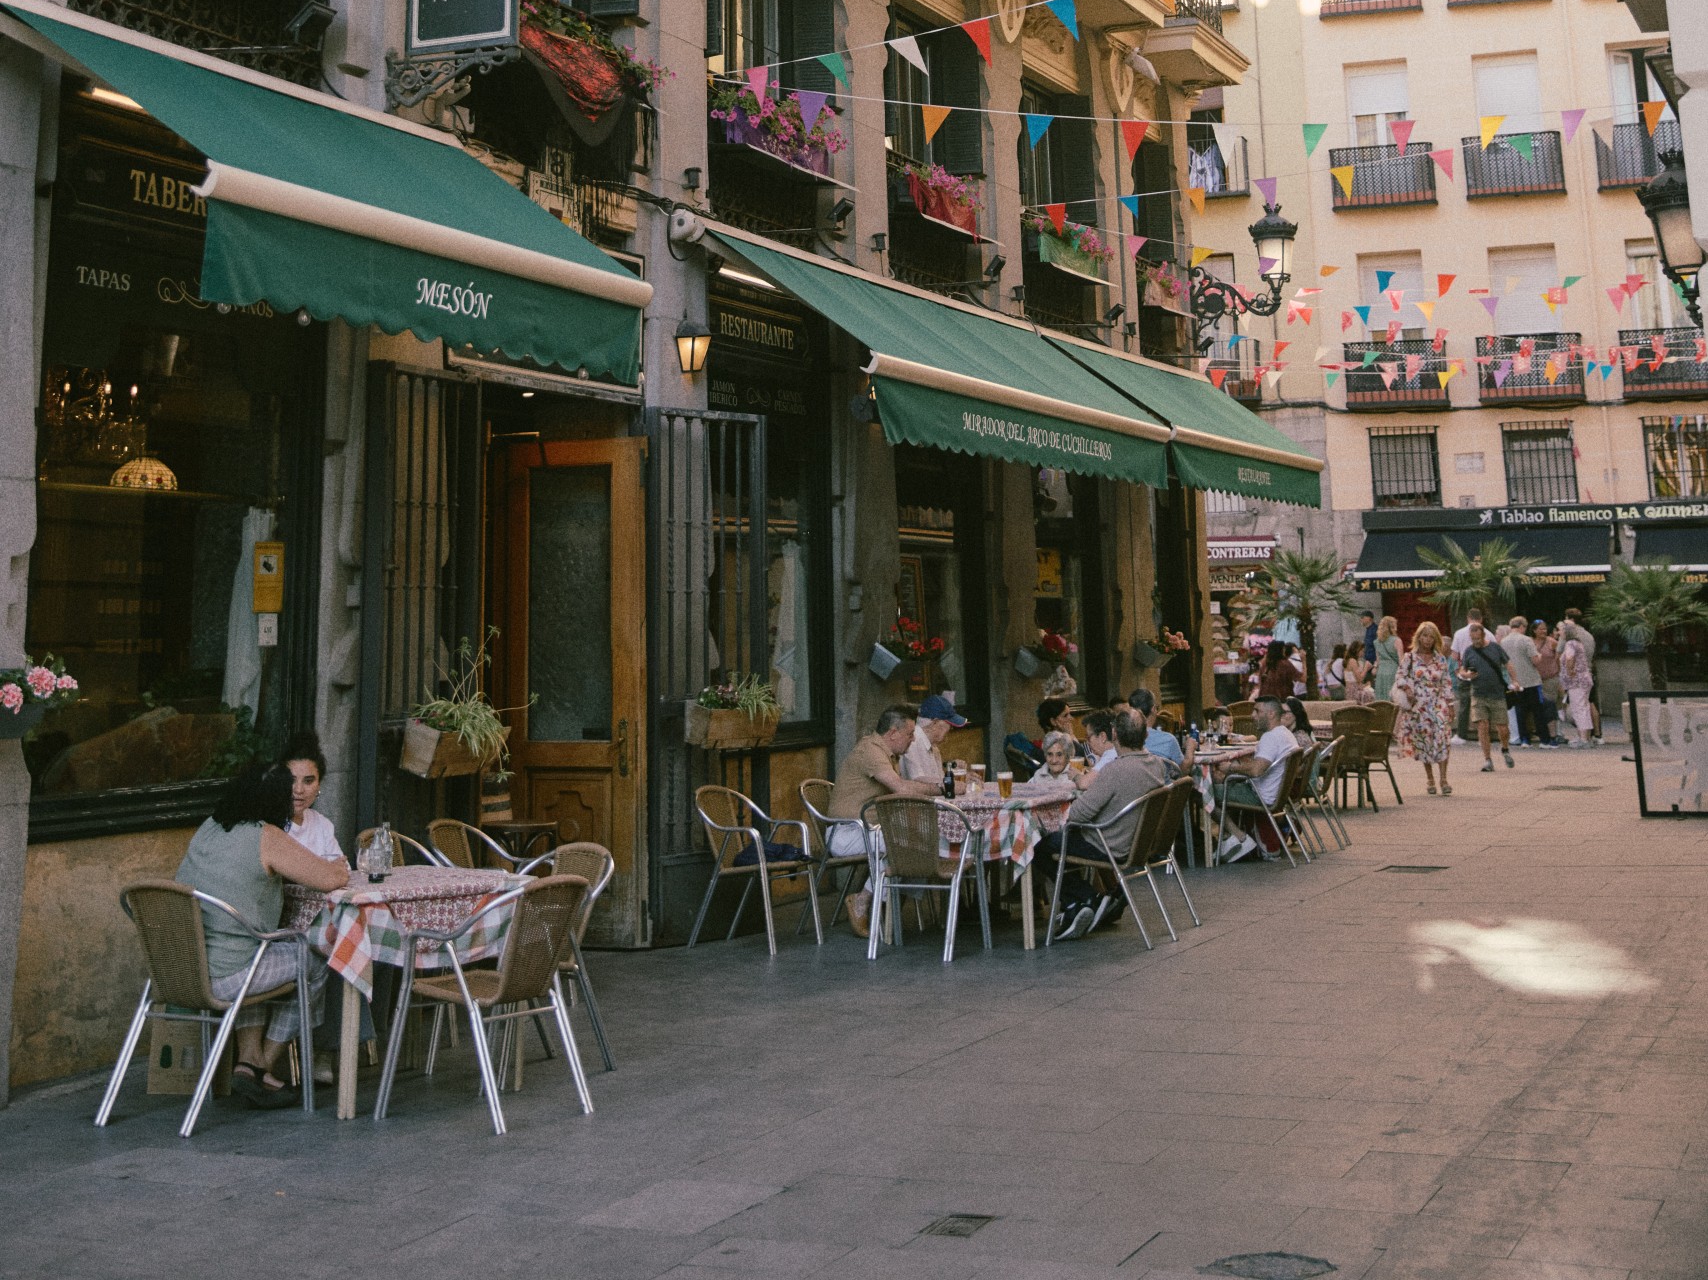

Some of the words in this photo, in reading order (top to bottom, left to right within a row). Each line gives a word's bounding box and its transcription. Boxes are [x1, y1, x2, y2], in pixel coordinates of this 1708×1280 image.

[76, 265, 131, 291] TAPAS
[416, 277, 493, 320] MESÓN
[719, 312, 794, 351] RESTAURANTE
[962, 411, 1009, 442] MIRADOR
[1007, 421, 1025, 442] DEL
[1026, 426, 1049, 449] ARCO
[1049, 431, 1062, 450] DE
[1062, 433, 1112, 461] CUCHILLEROS
[1497, 509, 1545, 524] Tablao
[1548, 507, 1612, 522] flamenco
[1615, 506, 1641, 520] LA
[1207, 547, 1271, 559] CONTRERAS
[1373, 579, 1411, 590] Tablao
